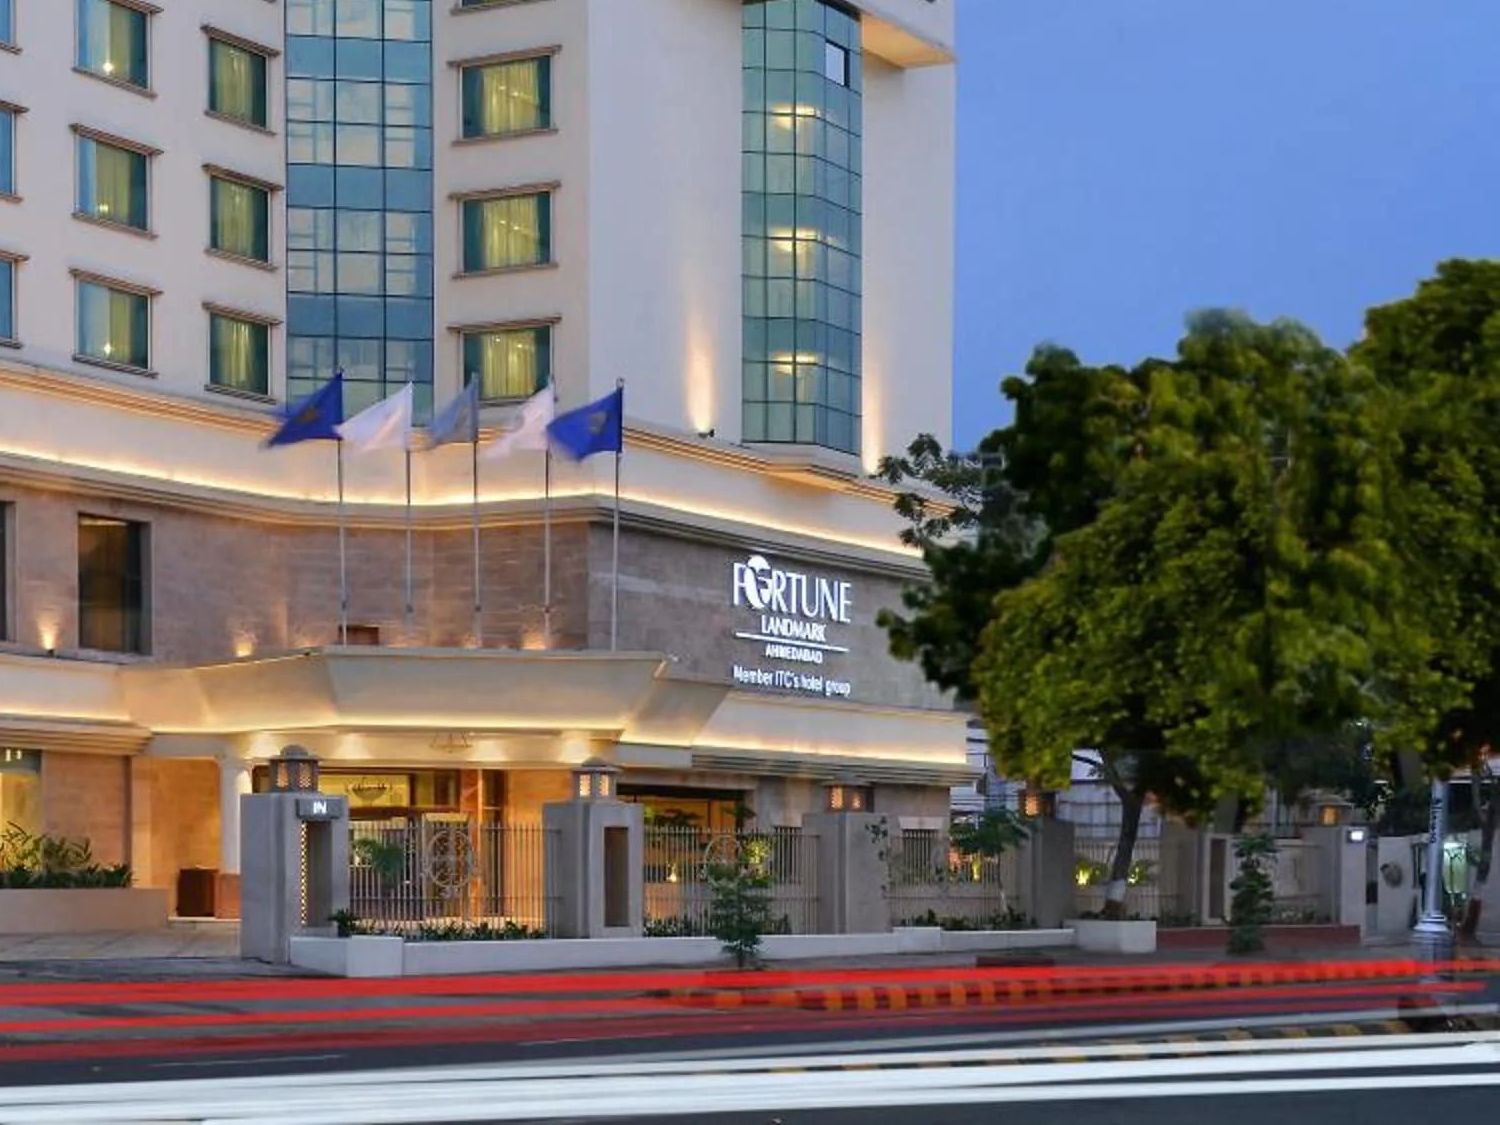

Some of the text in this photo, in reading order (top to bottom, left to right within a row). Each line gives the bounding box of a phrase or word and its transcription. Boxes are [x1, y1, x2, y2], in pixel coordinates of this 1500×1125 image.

[761, 614, 827, 642] LANDMARK
[765, 643, 823, 664] AHMEDABAD
[733, 665, 773, 685] Member
[801, 674, 823, 692] hotel
[825, 680, 851, 697] group
[313, 800, 327, 814] IN
